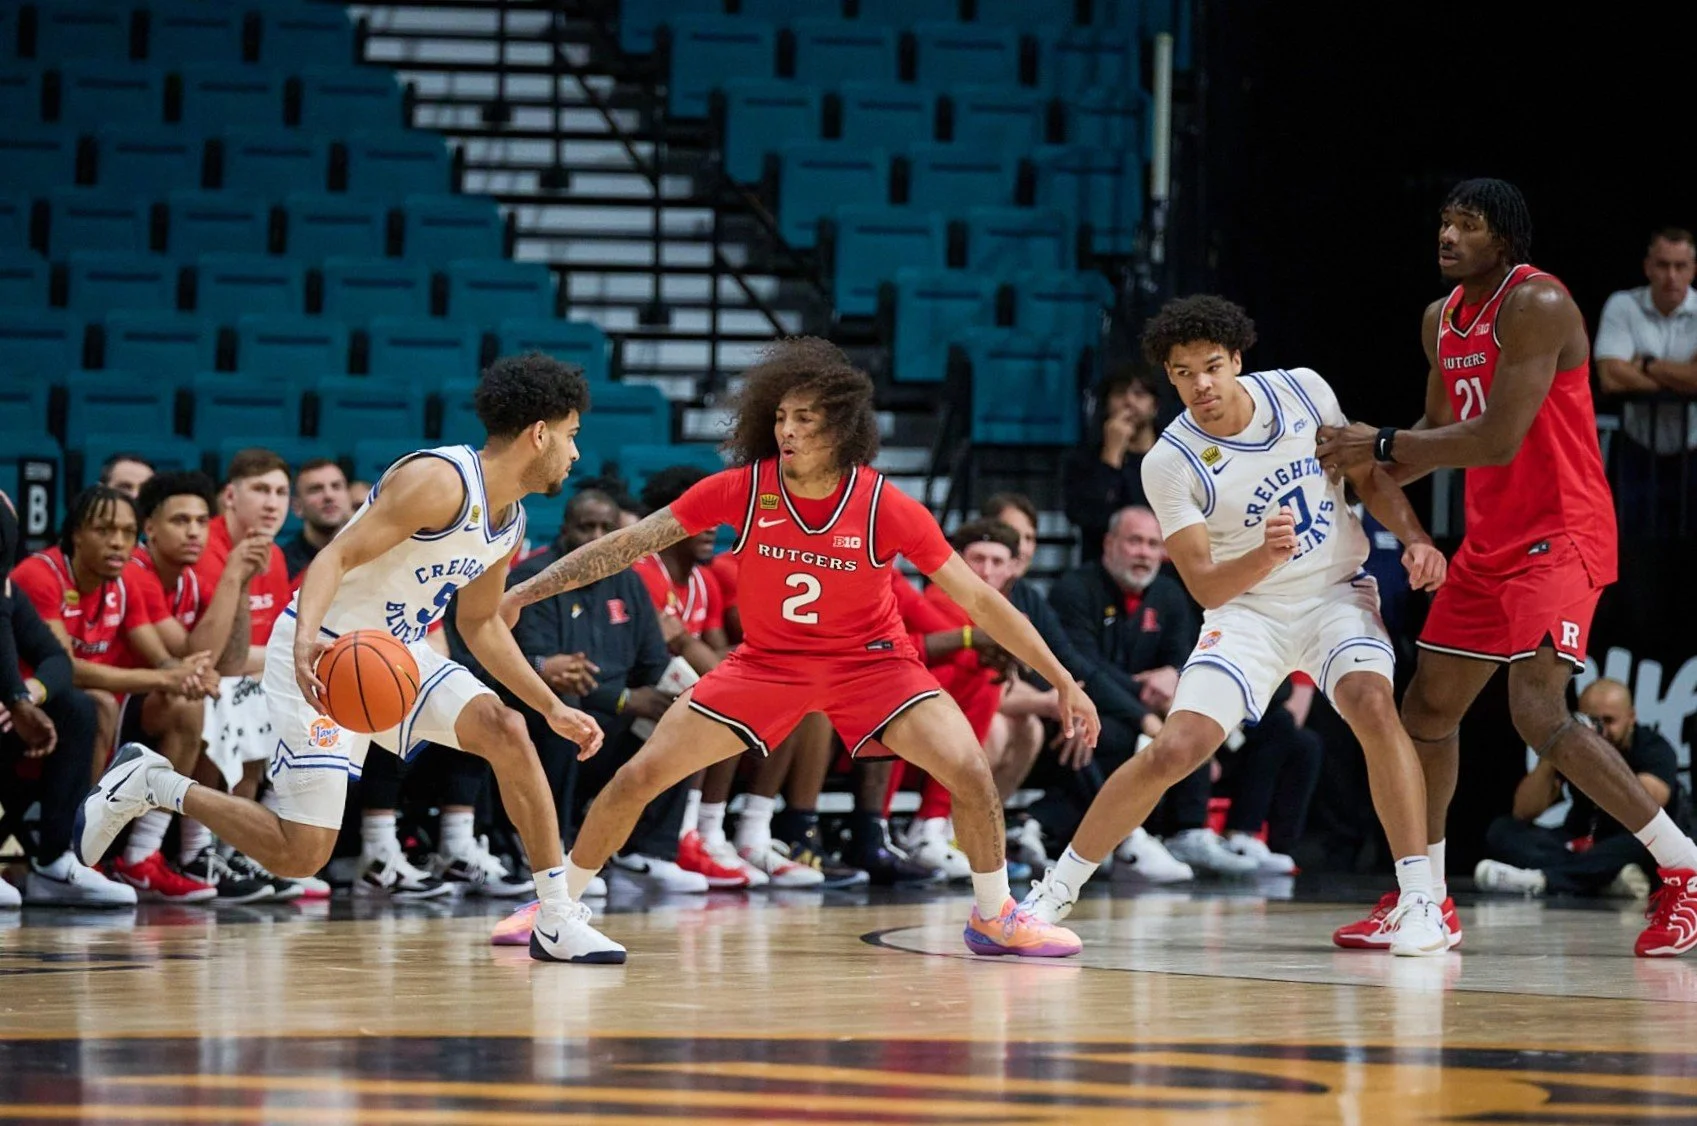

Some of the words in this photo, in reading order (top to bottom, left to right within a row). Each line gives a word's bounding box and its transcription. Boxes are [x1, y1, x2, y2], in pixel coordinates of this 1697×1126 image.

[1455, 376, 1487, 421] 21
[28, 484, 48, 536] B
[1244, 457, 1323, 528] CREIGHTO
[414, 557, 485, 584] CREIGH
[758, 543, 858, 572] RUTGERS
[416, 581, 459, 624] 5
[781, 572, 822, 625] 2
[385, 601, 428, 644] BLUEJA
[1560, 620, 1580, 649] R
